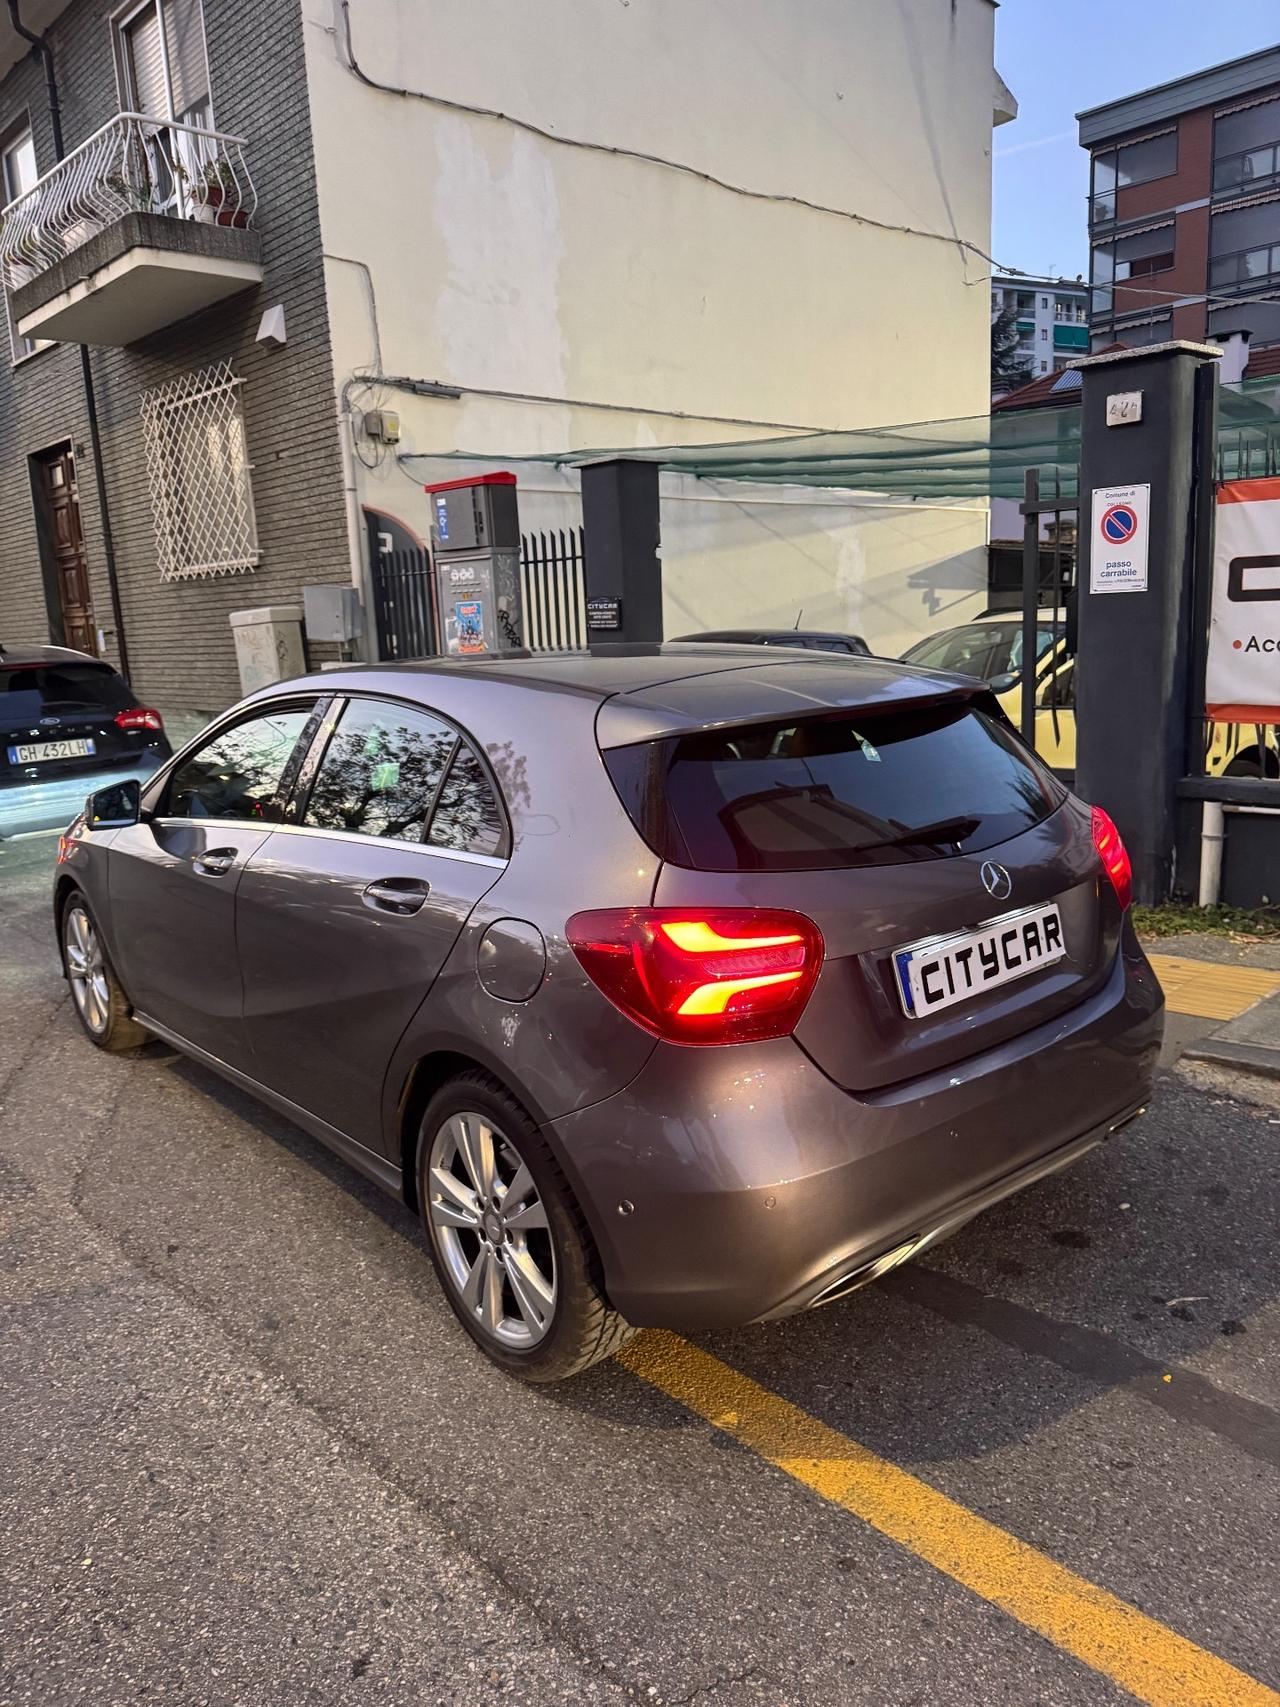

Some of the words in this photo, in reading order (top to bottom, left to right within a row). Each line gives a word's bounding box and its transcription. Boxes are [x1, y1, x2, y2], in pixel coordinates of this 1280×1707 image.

[1100, 569, 1138, 577] carrabile
[1106, 561, 1132, 569] passo
[1244, 635, 1280, 653] Ac
[19, 745, 38, 761] GH
[42, 740, 87, 758] 432LH
[921, 913, 1062, 1005] CITYCAR
